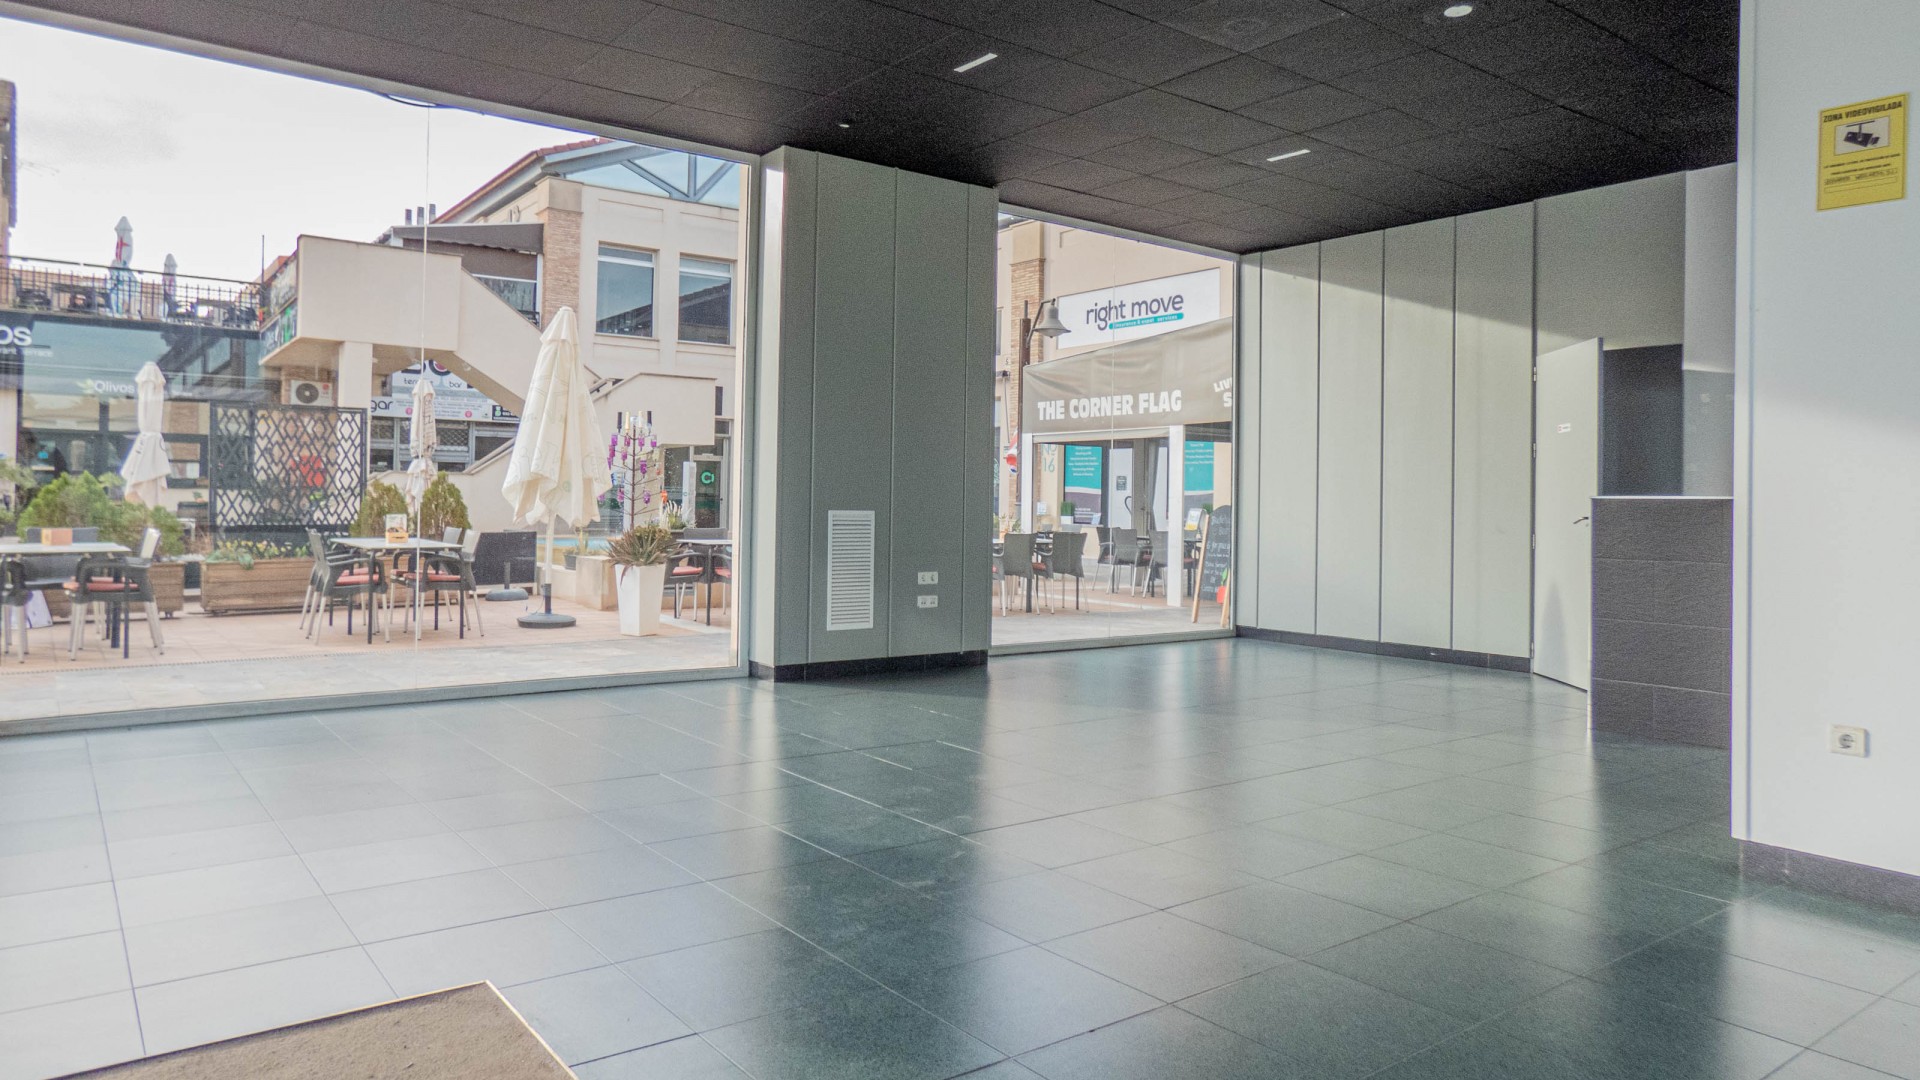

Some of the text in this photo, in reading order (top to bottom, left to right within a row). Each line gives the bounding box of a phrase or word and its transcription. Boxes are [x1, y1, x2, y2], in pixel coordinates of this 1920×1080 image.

[1823, 101, 1903, 123] ZONA VIDEOVIGILADA
[1086, 294, 1184, 331] right move
[94, 380, 135, 394] Olivos
[1037, 389, 1182, 420] THE CORNER FLAG
[1043, 457, 1055, 473] 16
